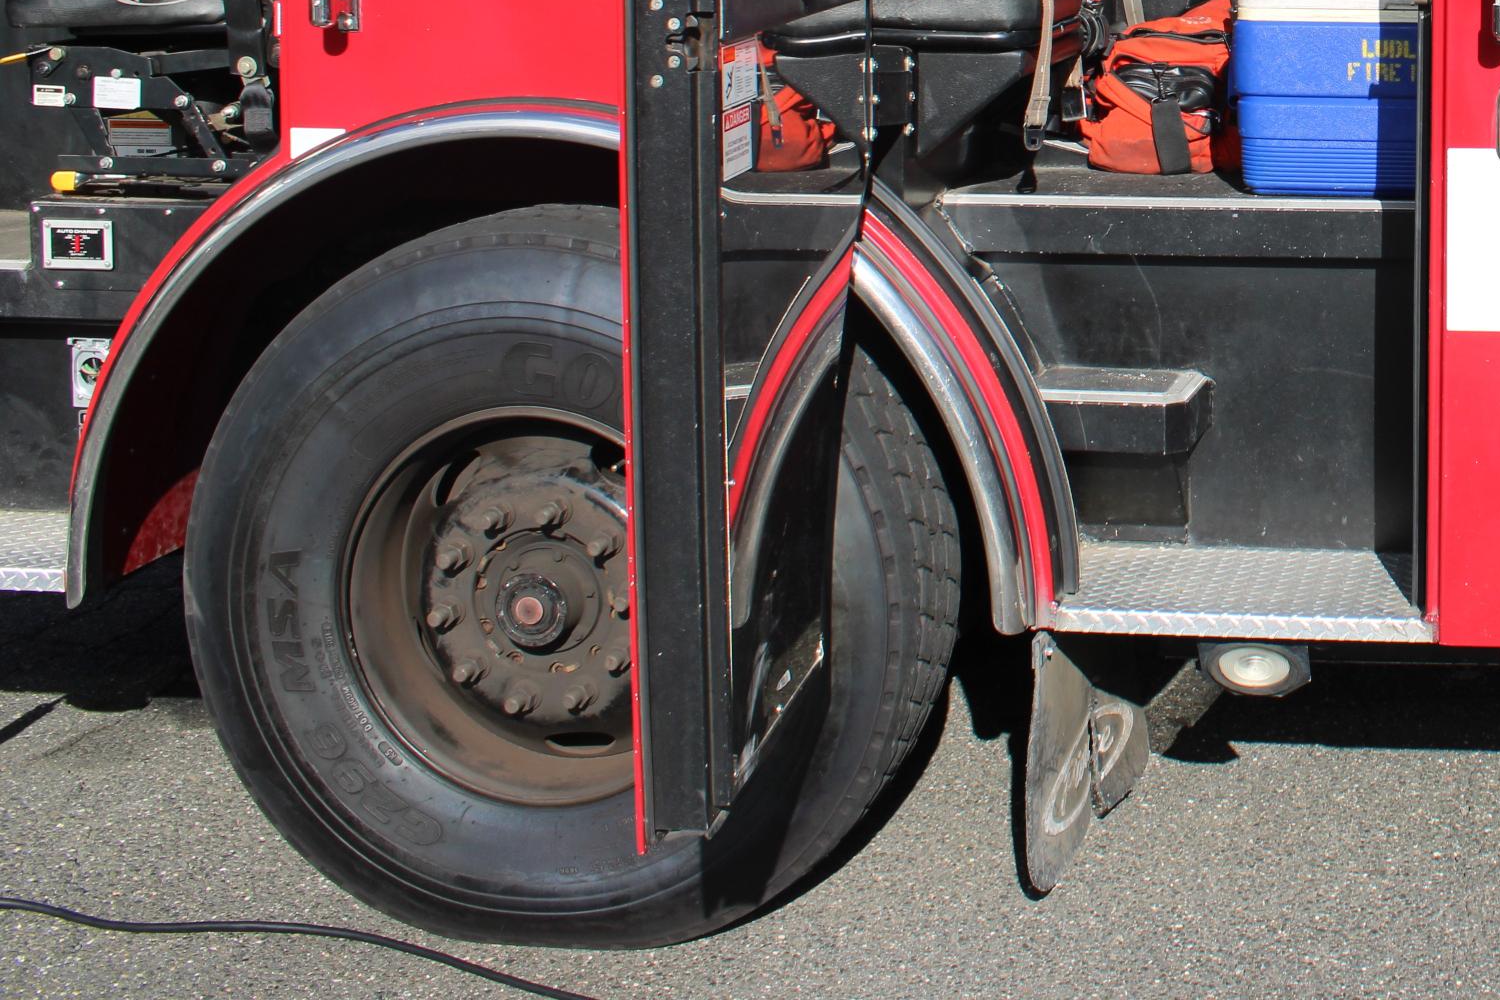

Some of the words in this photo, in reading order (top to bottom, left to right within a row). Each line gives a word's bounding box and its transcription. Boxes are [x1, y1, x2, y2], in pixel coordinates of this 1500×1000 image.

[1347, 62, 1402, 82] FIRE
[729, 105, 750, 128] DANGER
[267, 548, 315, 693] MSA
